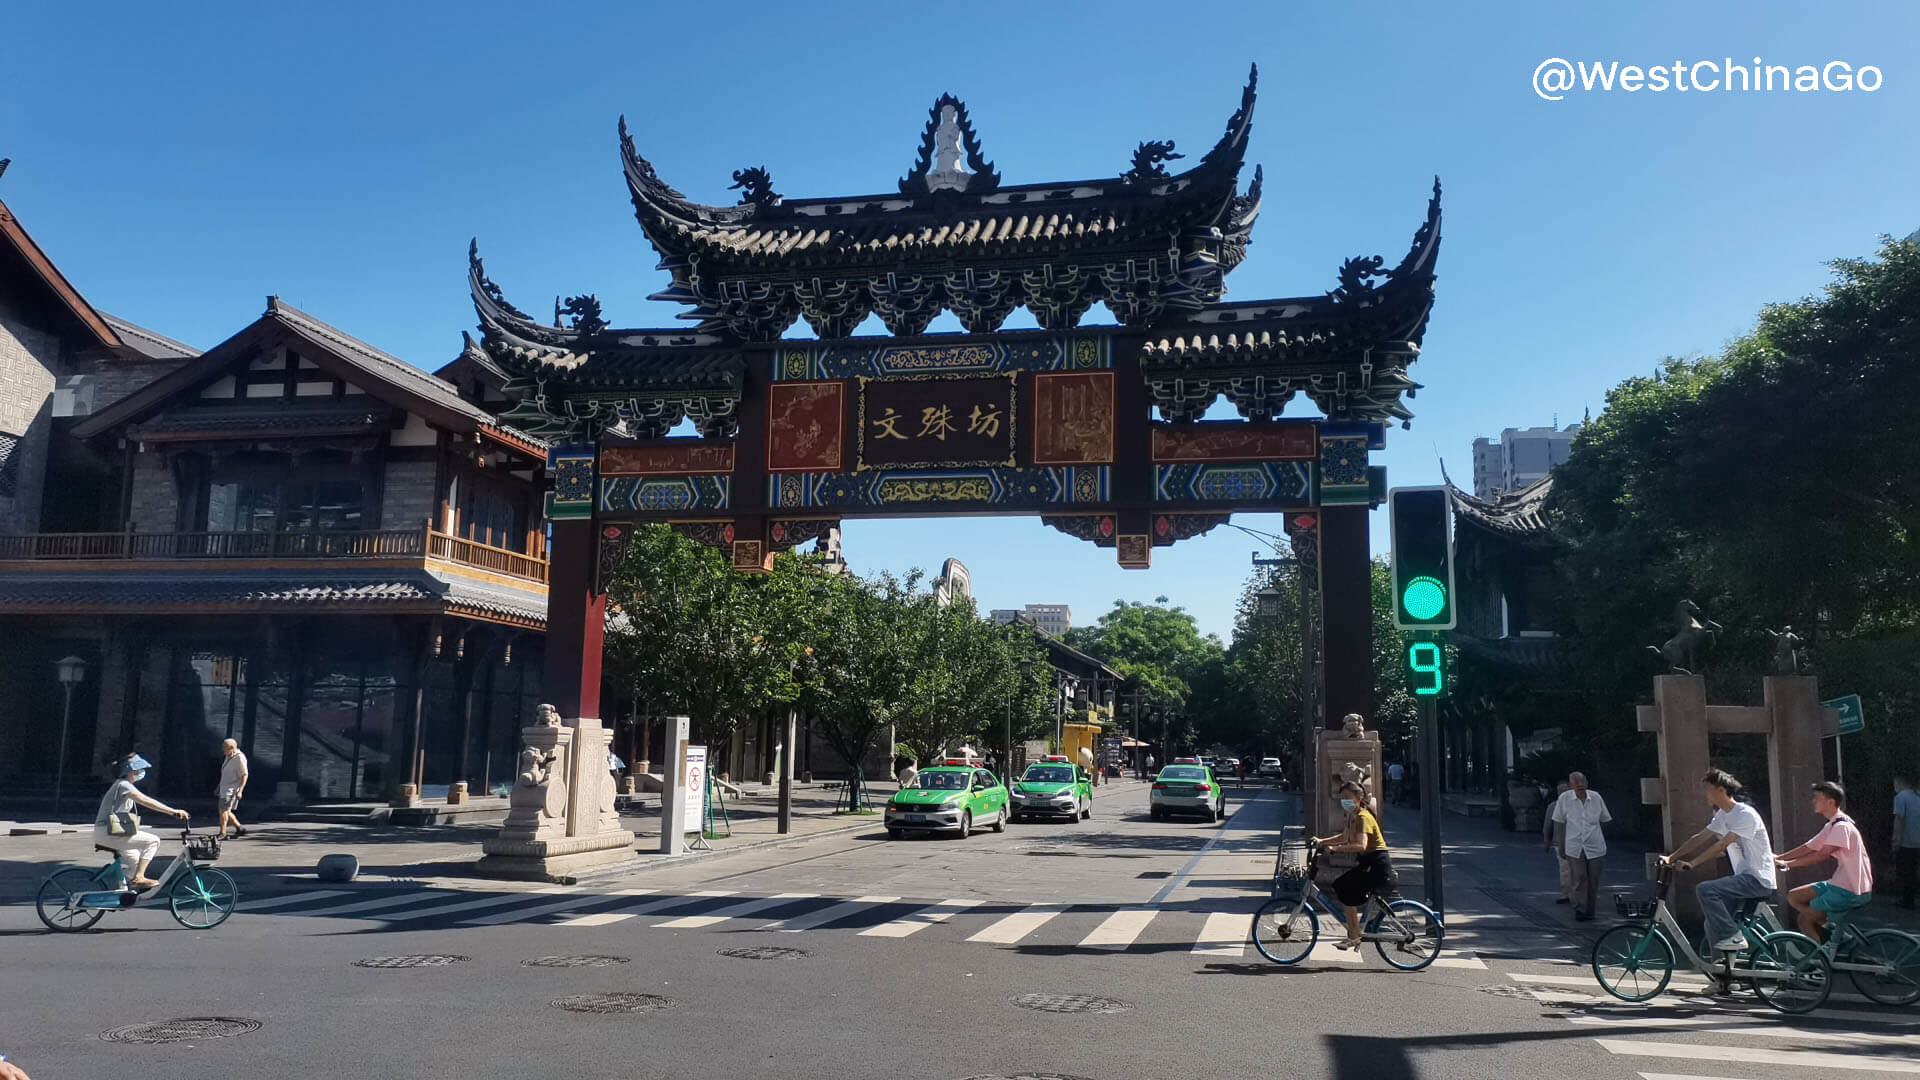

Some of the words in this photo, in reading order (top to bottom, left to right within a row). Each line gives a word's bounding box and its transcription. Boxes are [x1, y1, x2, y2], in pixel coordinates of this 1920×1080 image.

[872, 403, 1002, 441] 文殊坊
[1410, 642, 1442, 694] 9
